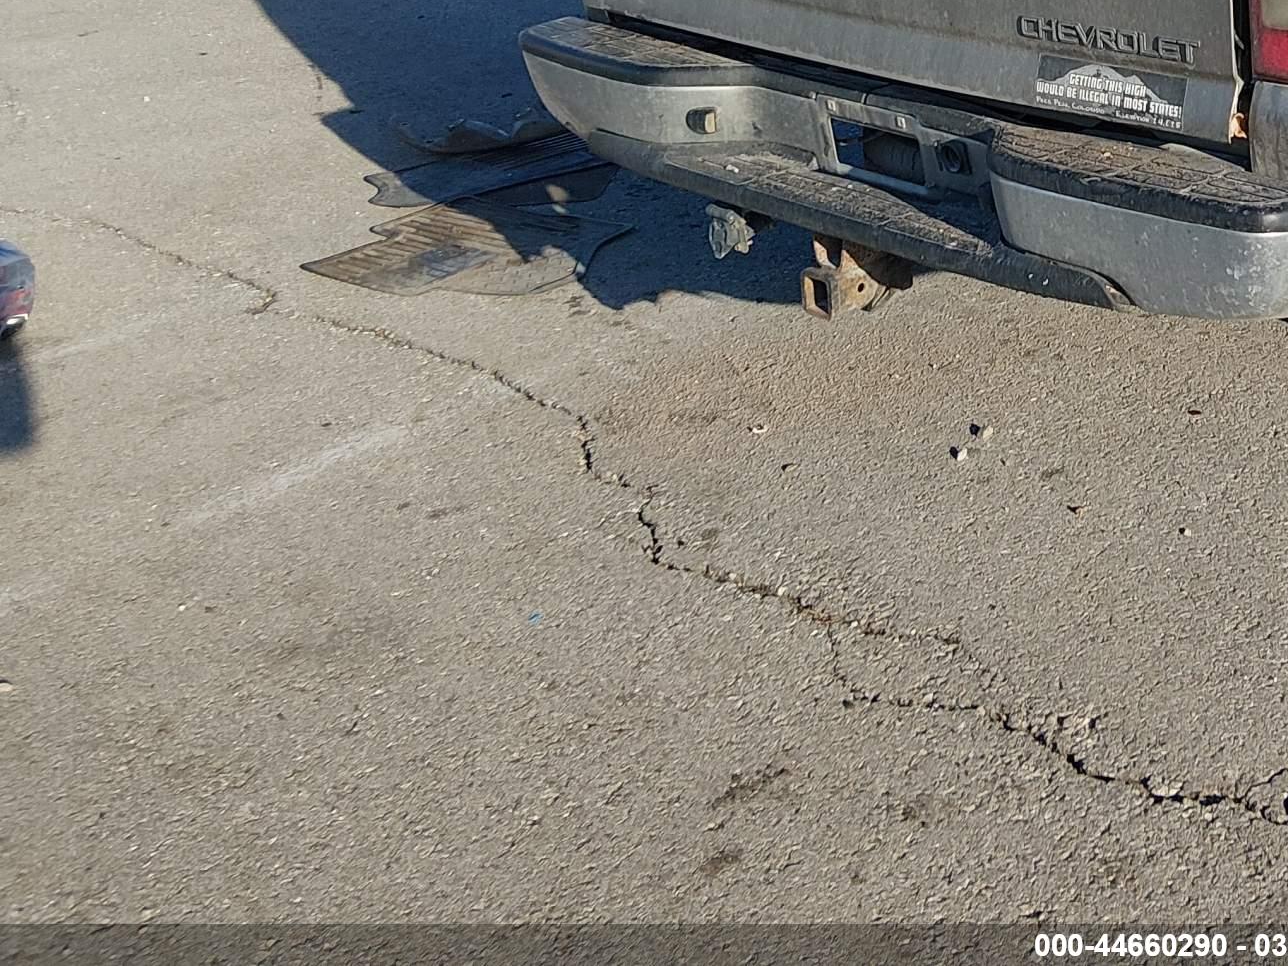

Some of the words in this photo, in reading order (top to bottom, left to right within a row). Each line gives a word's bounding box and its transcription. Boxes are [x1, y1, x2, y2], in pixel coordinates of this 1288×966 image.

[1018, 16, 1200, 67] CHEVROLET
[1036, 81, 1065, 96] WOULD
[1066, 86, 1077, 99] BE
[1079, 87, 1109, 104] ILLEGAL
[1111, 94, 1121, 106] IN
[1123, 95, 1148, 111] MOST
[1149, 101, 1183, 119] STATES!
[1069, 74, 1104, 90] GETTING
[1104, 77, 1124, 93] THIS
[1124, 83, 1147, 96] HIGH
